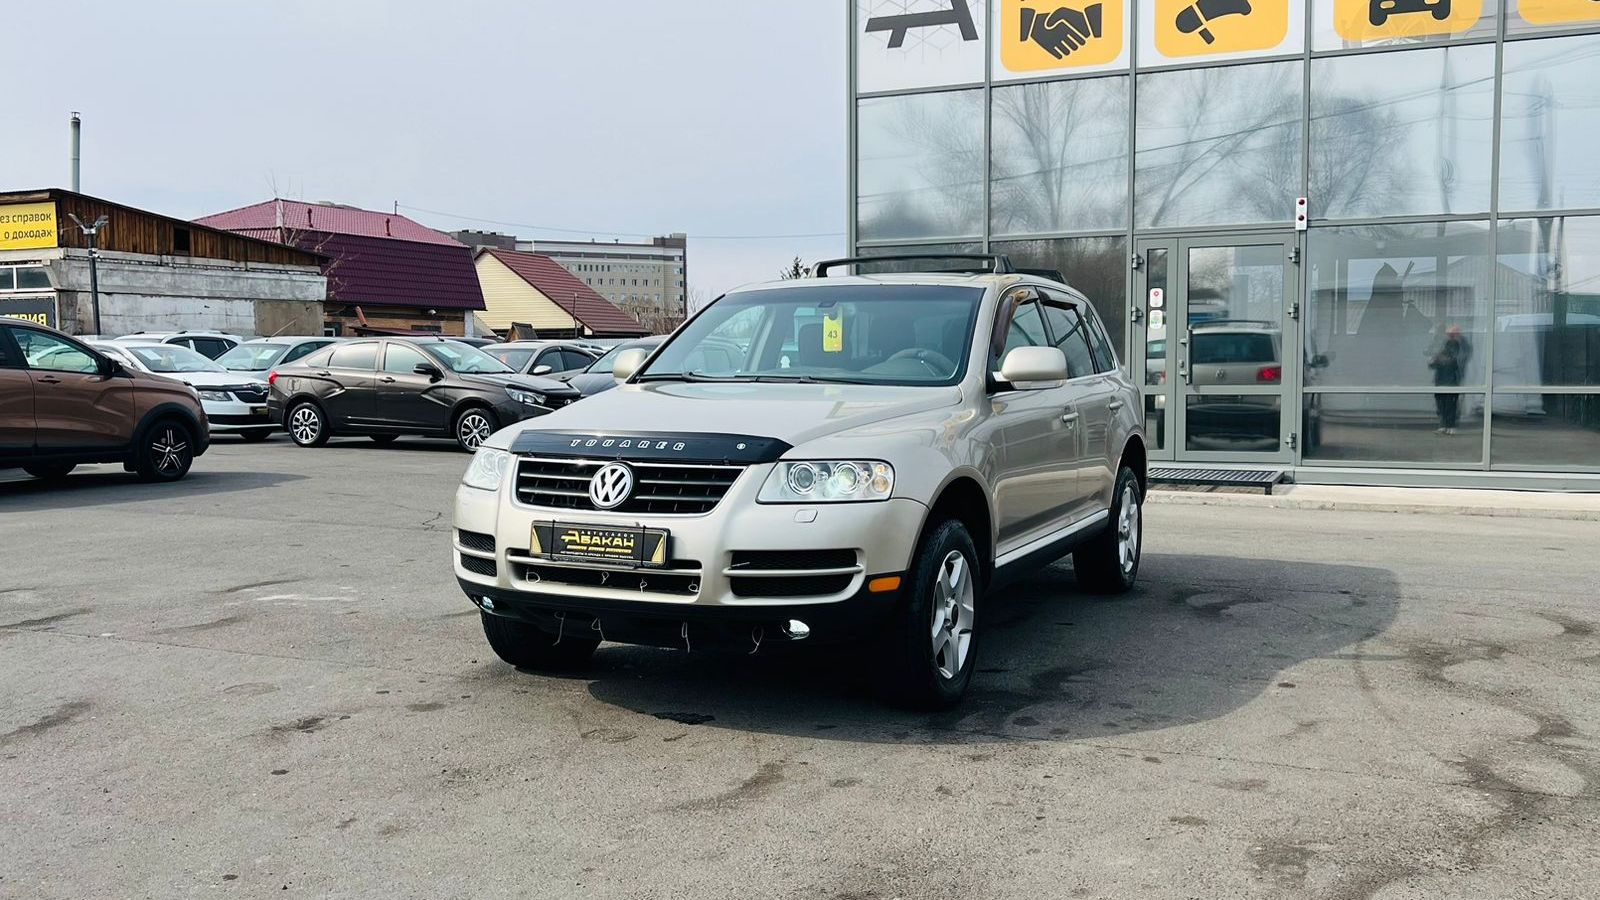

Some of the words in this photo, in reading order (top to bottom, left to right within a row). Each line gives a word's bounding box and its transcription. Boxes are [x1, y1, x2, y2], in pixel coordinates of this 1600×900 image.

[12, 213, 52, 224] справок
[4, 231, 10, 239] о
[12, 229, 52, 240] доходах
[828, 330, 838, 339] 43
